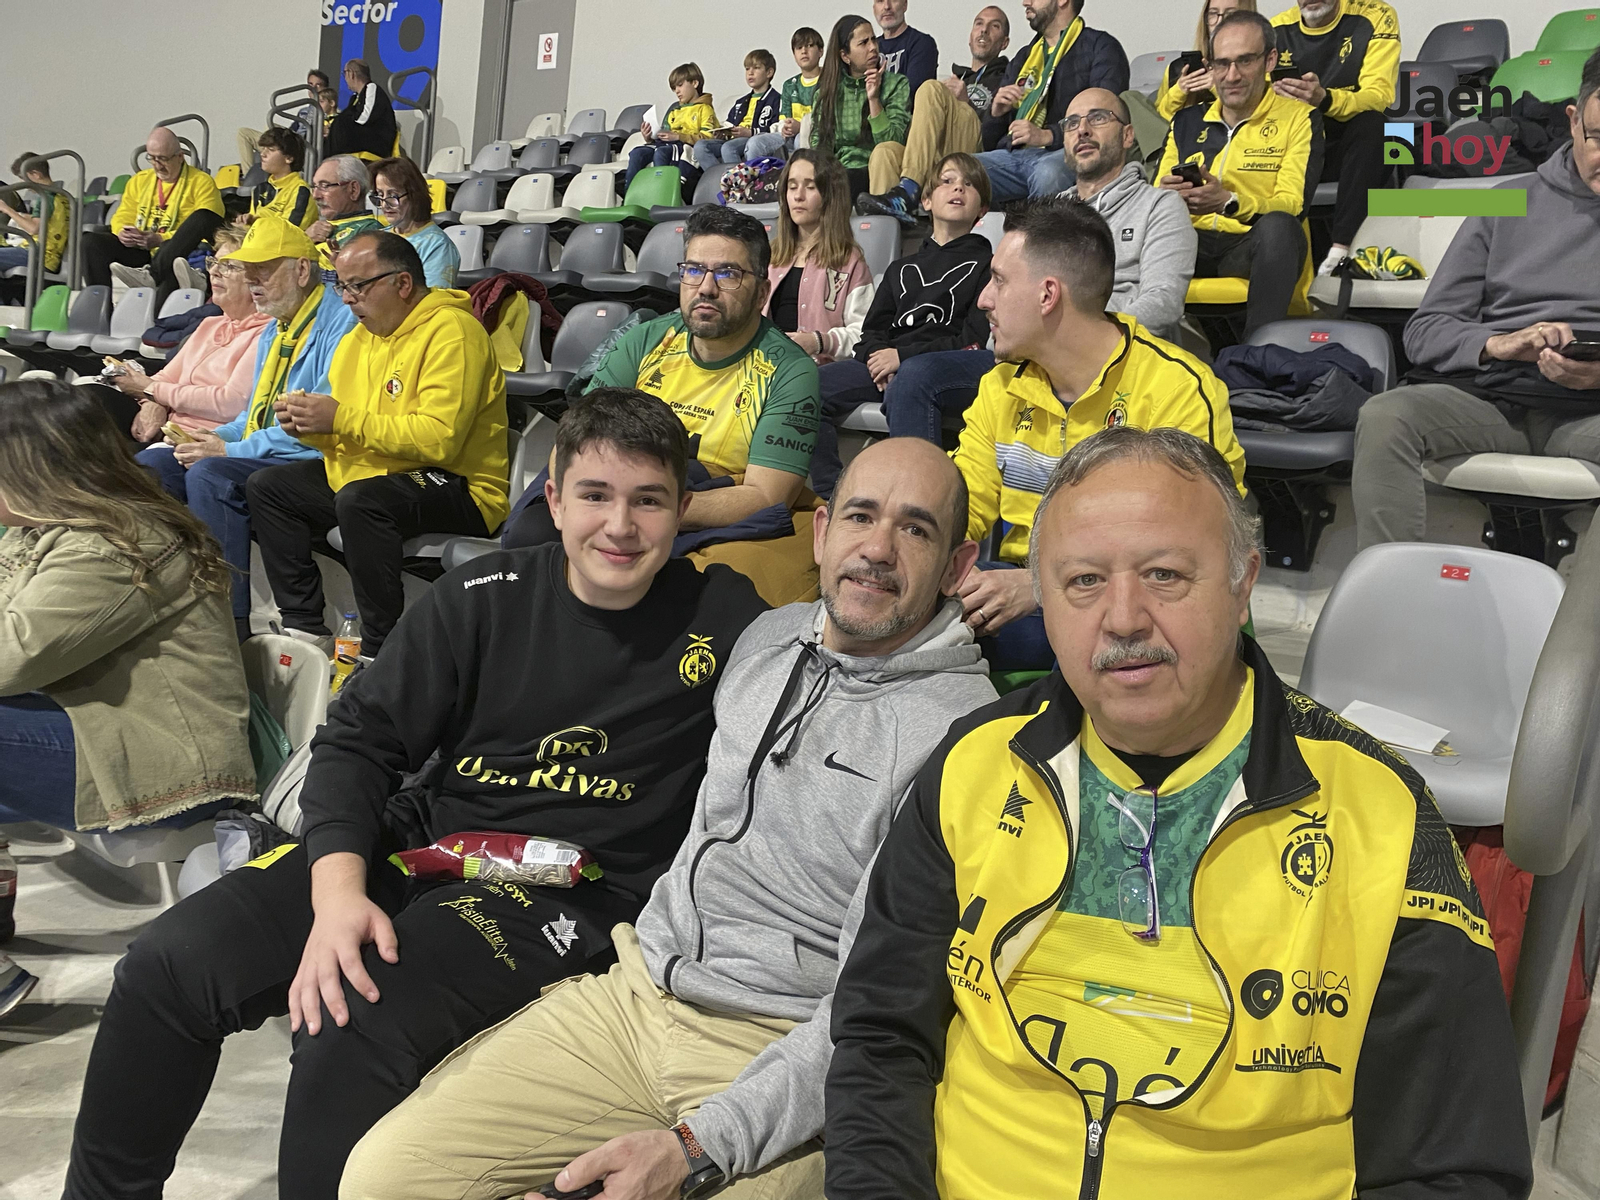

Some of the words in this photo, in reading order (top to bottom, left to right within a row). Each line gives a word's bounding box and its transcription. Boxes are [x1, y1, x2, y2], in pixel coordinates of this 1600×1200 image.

[321, 0, 399, 26] Sector
[693, 405, 715, 417] ESPAÑA
[1451, 568, 1460, 578] 2
[689, 648, 709, 656] JAEN
[525, 762, 636, 801] Rivas
[1407, 895, 1435, 910] JPI
[1438, 900, 1461, 918] JPI
